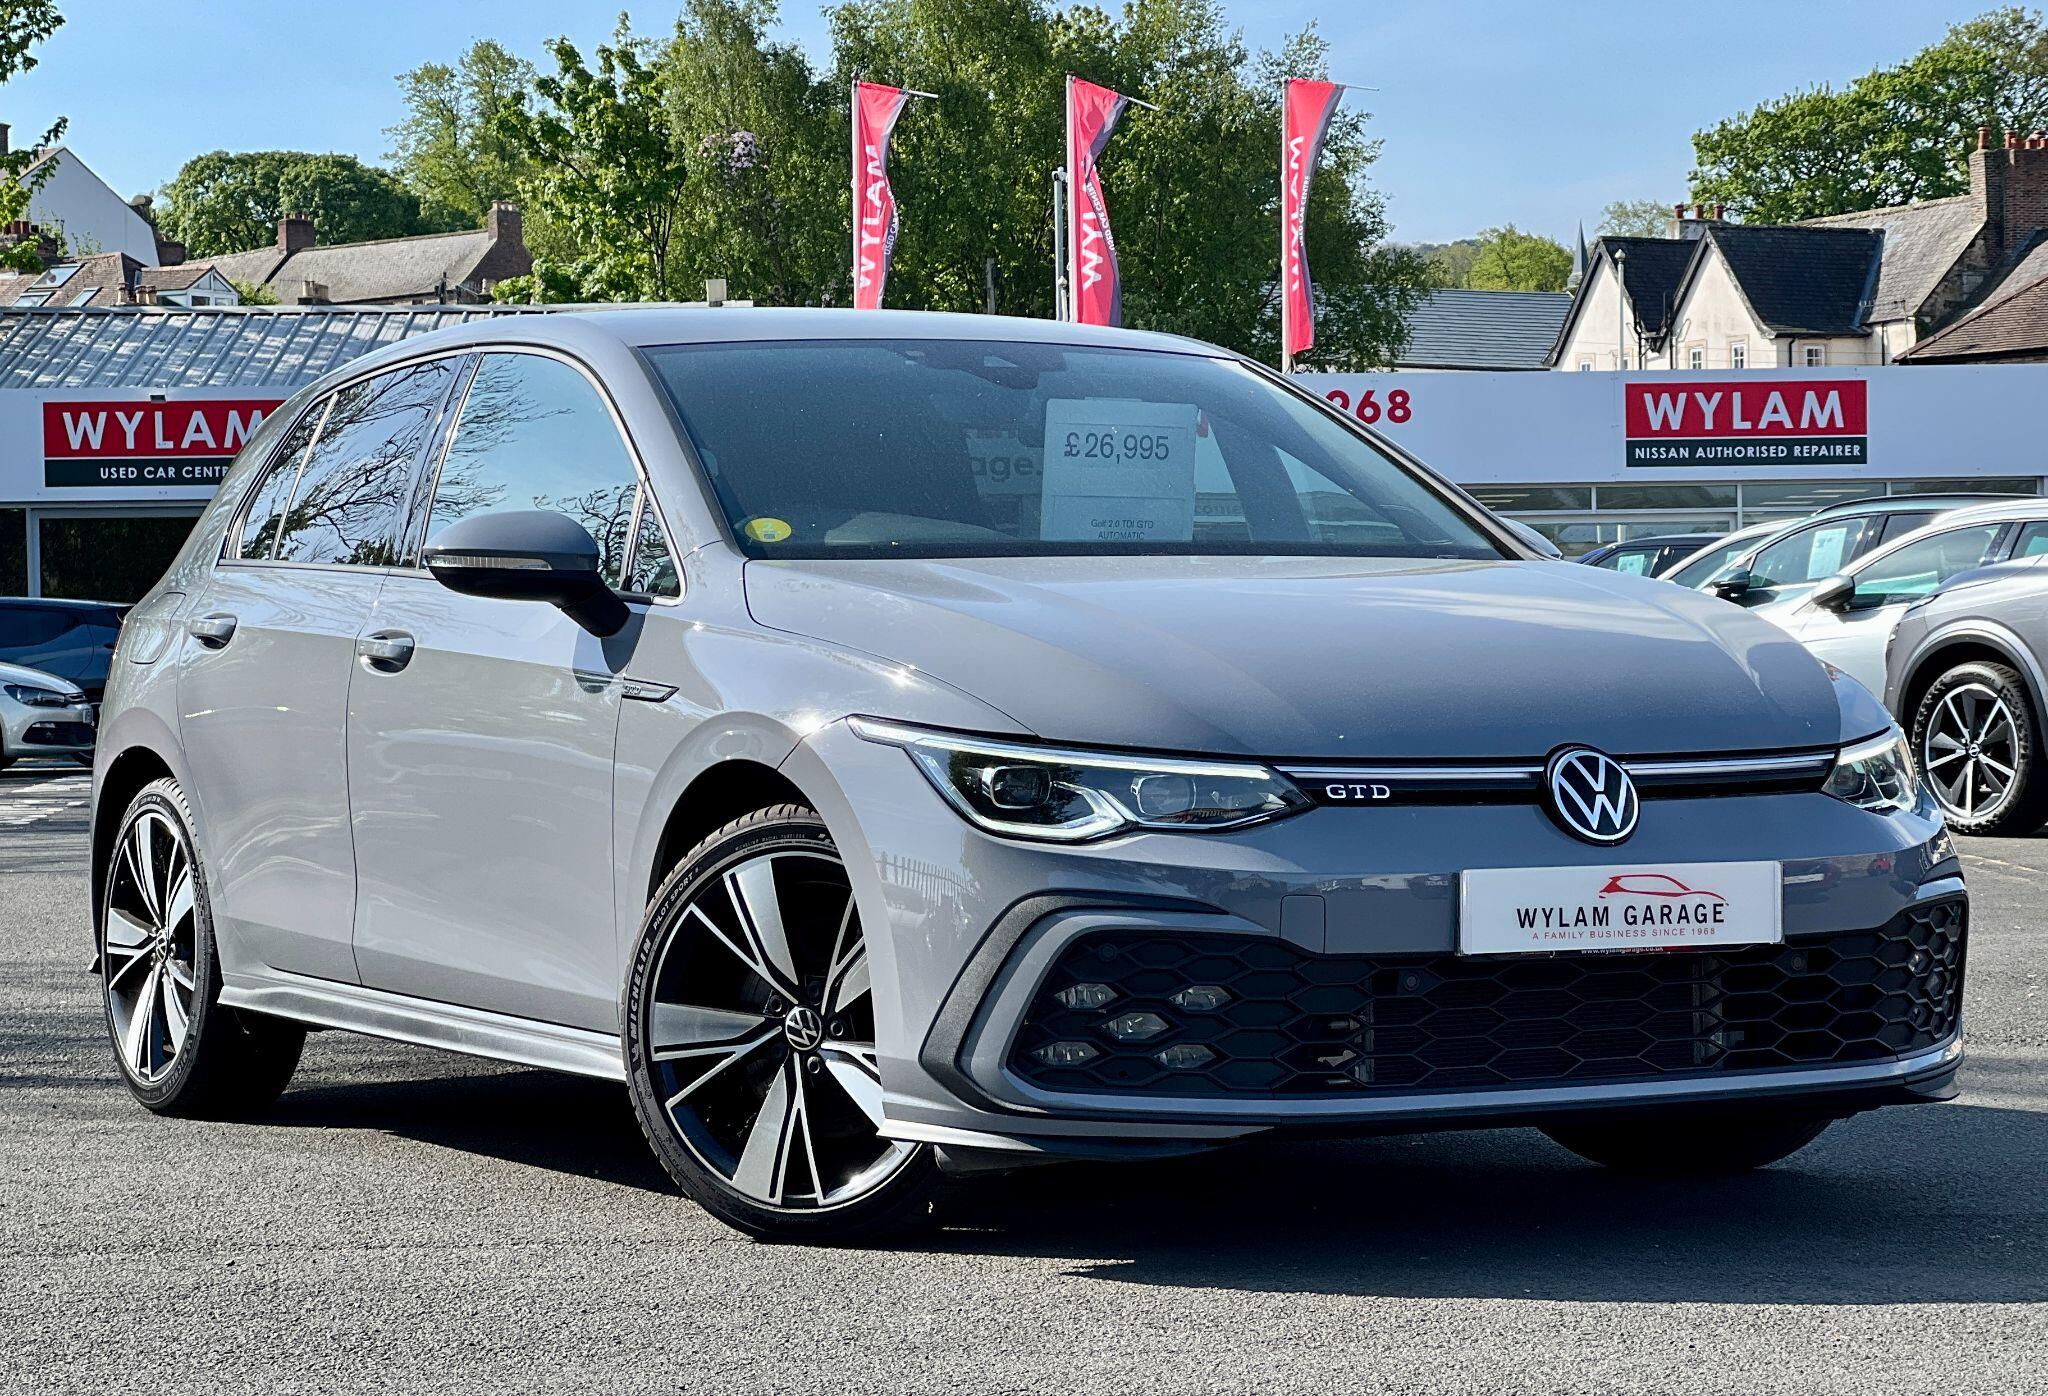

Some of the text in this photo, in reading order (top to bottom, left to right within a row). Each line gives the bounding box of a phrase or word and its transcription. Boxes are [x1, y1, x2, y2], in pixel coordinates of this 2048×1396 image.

[1643, 390, 1845, 431] WYLAM
[62, 410, 265, 450] WYLAM
[1064, 432, 1170, 464] £26,995
[1635, 444, 1861, 459] NISSAN AUTHORISED REPAIRER
[100, 466, 137, 479] USED
[143, 466, 176, 479] CAR
[1097, 531, 1146, 541] AUTOMATIC
[1325, 784, 1391, 799] GTD
[1516, 902, 1725, 929] WYLAM GARAGE
[1532, 927, 1716, 940] A FAMILY BUSINESS SINCE 1968
[630, 937, 652, 1044] MICHELIN
[652, 902, 670, 930] PILOT
[670, 872, 693, 902] SPORT
